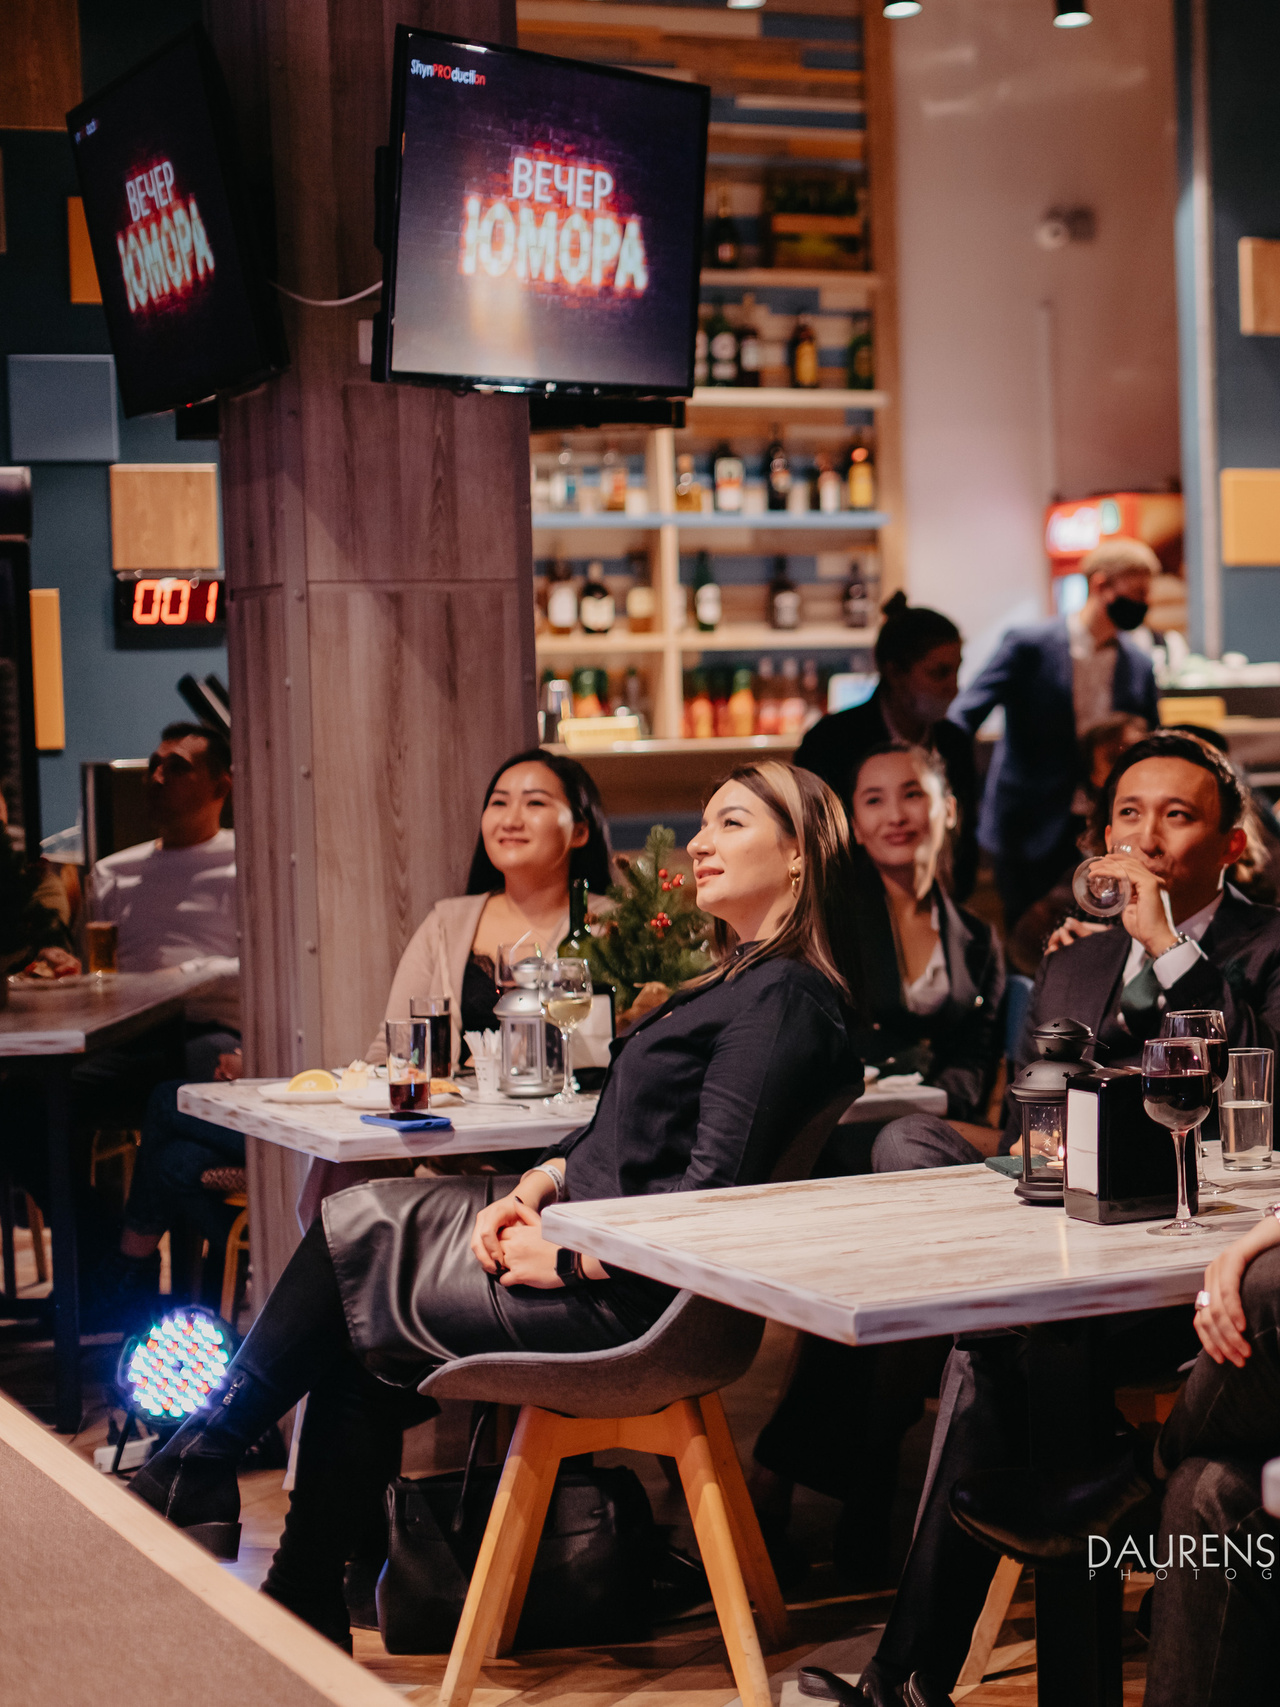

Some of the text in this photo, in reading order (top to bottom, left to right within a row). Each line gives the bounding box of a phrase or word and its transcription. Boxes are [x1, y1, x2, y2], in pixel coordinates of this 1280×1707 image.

[125, 161, 175, 222] ВЕЧЕР
[511, 156, 614, 210] ВЕЧЕР
[117, 199, 216, 314] ЮМОРА
[460, 196, 650, 291] ЮМОРА
